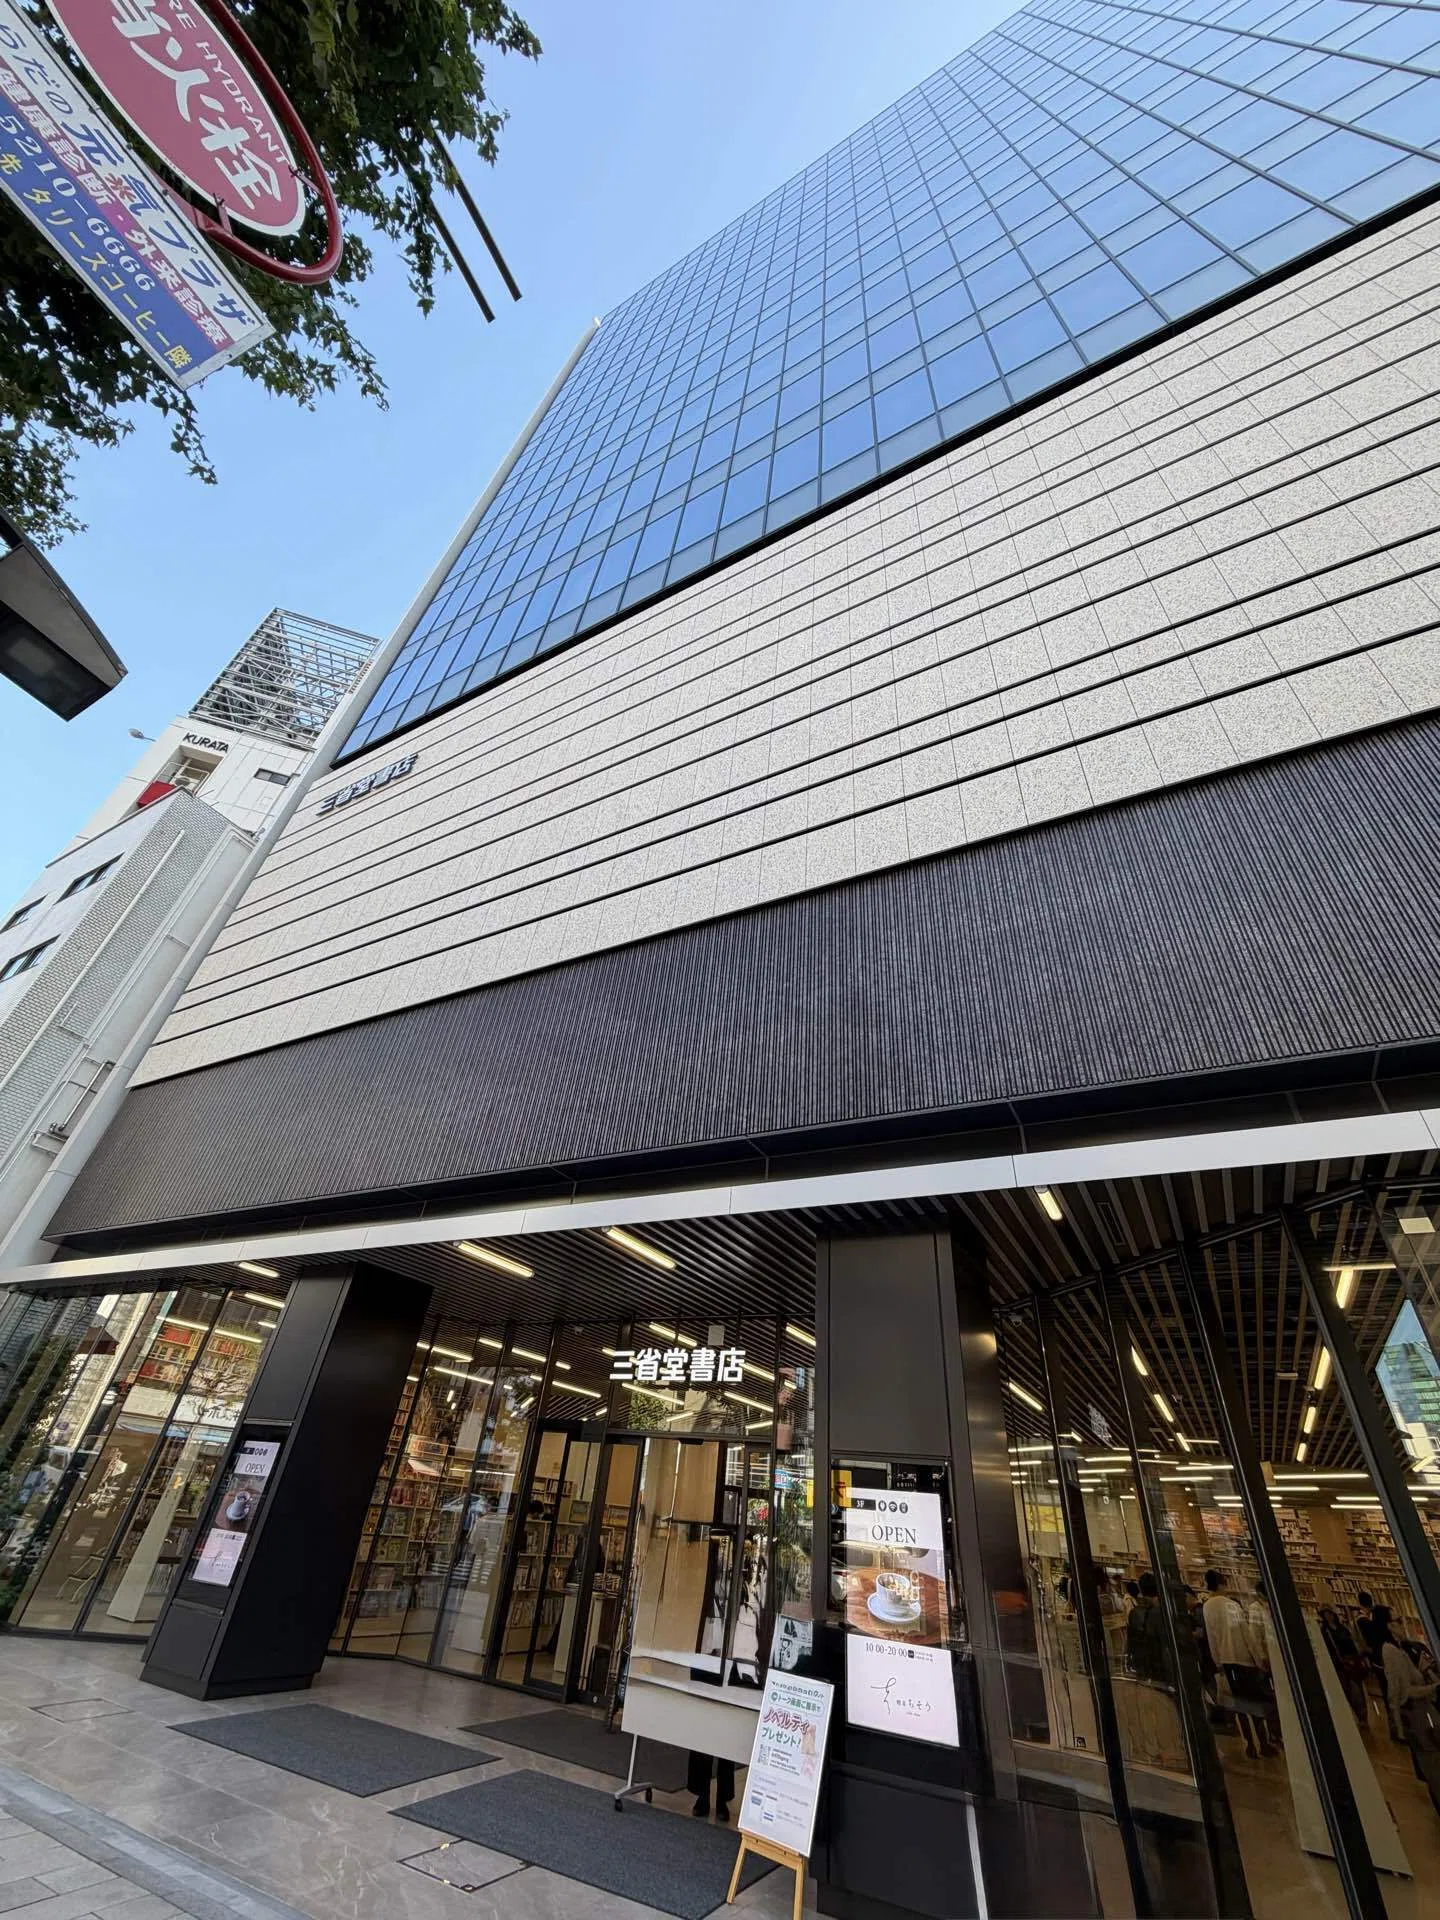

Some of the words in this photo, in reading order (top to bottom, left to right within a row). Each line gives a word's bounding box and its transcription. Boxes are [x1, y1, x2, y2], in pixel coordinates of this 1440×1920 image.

[196, 41, 291, 165] HYDRANT
[182, 731, 230, 754] KURATA
[609, 1346, 746, 1382] 三省堂書店
[871, 1524, 917, 1544] OPEN
[865, 1642, 908, 1657] 1000-2000
[763, 1707, 810, 1735] ノベルティ
